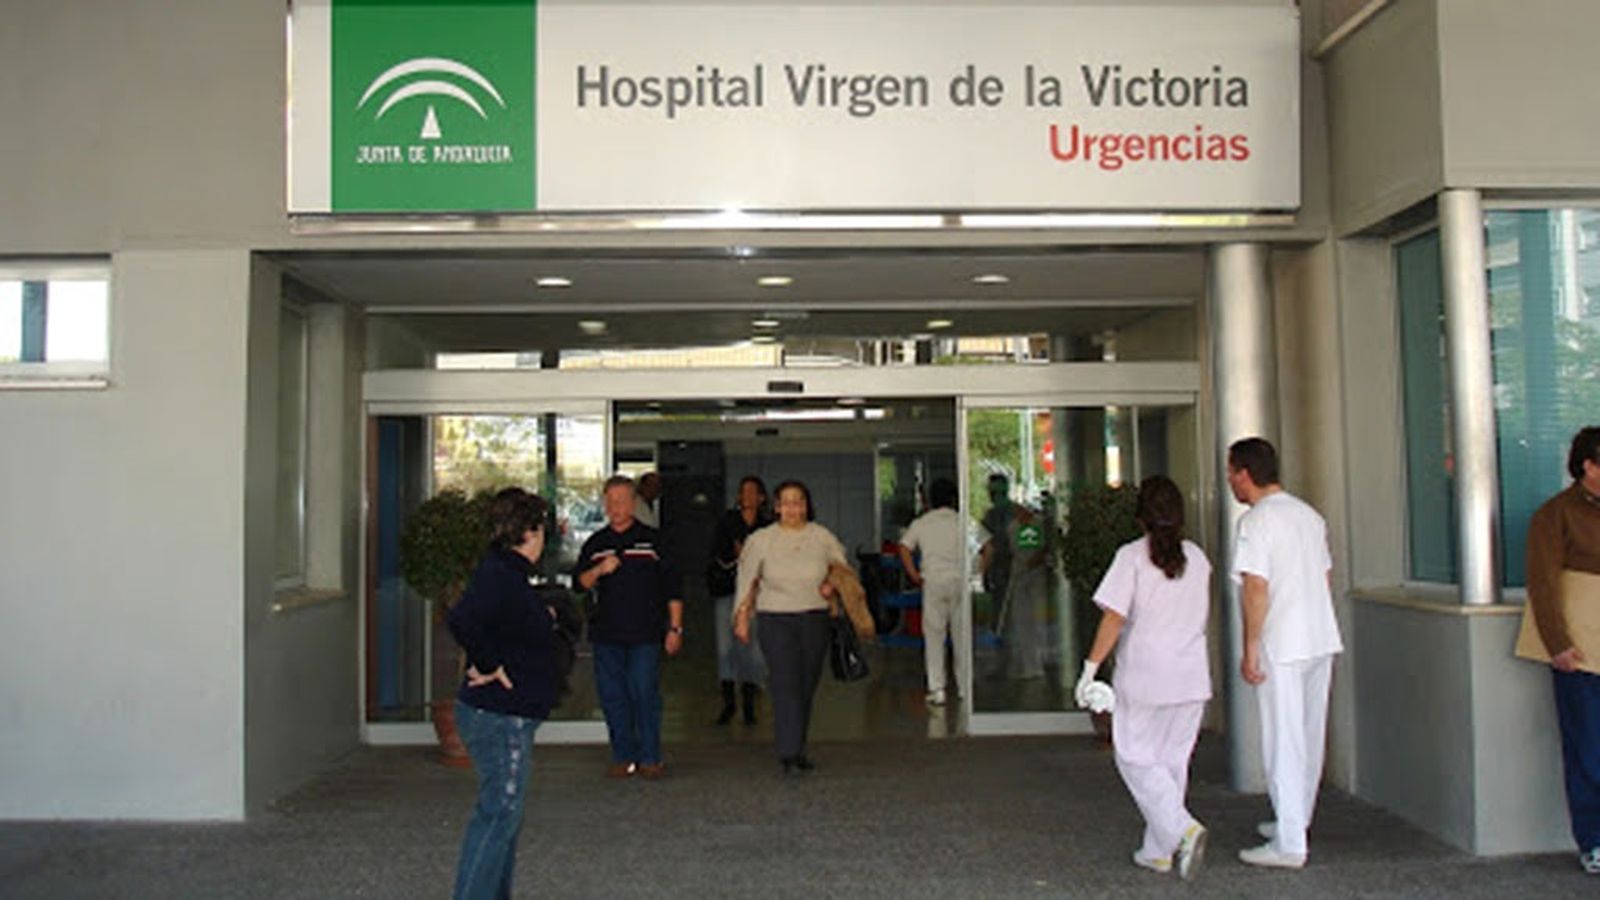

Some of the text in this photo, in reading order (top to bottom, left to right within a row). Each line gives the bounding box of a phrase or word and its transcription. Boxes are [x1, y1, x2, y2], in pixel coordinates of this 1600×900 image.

[577, 64, 1249, 119] Hospital Virgen de la Victoria
[356, 145, 403, 164] JUNTA
[408, 145, 427, 164] DE
[1048, 124, 1250, 171] Urgencias
